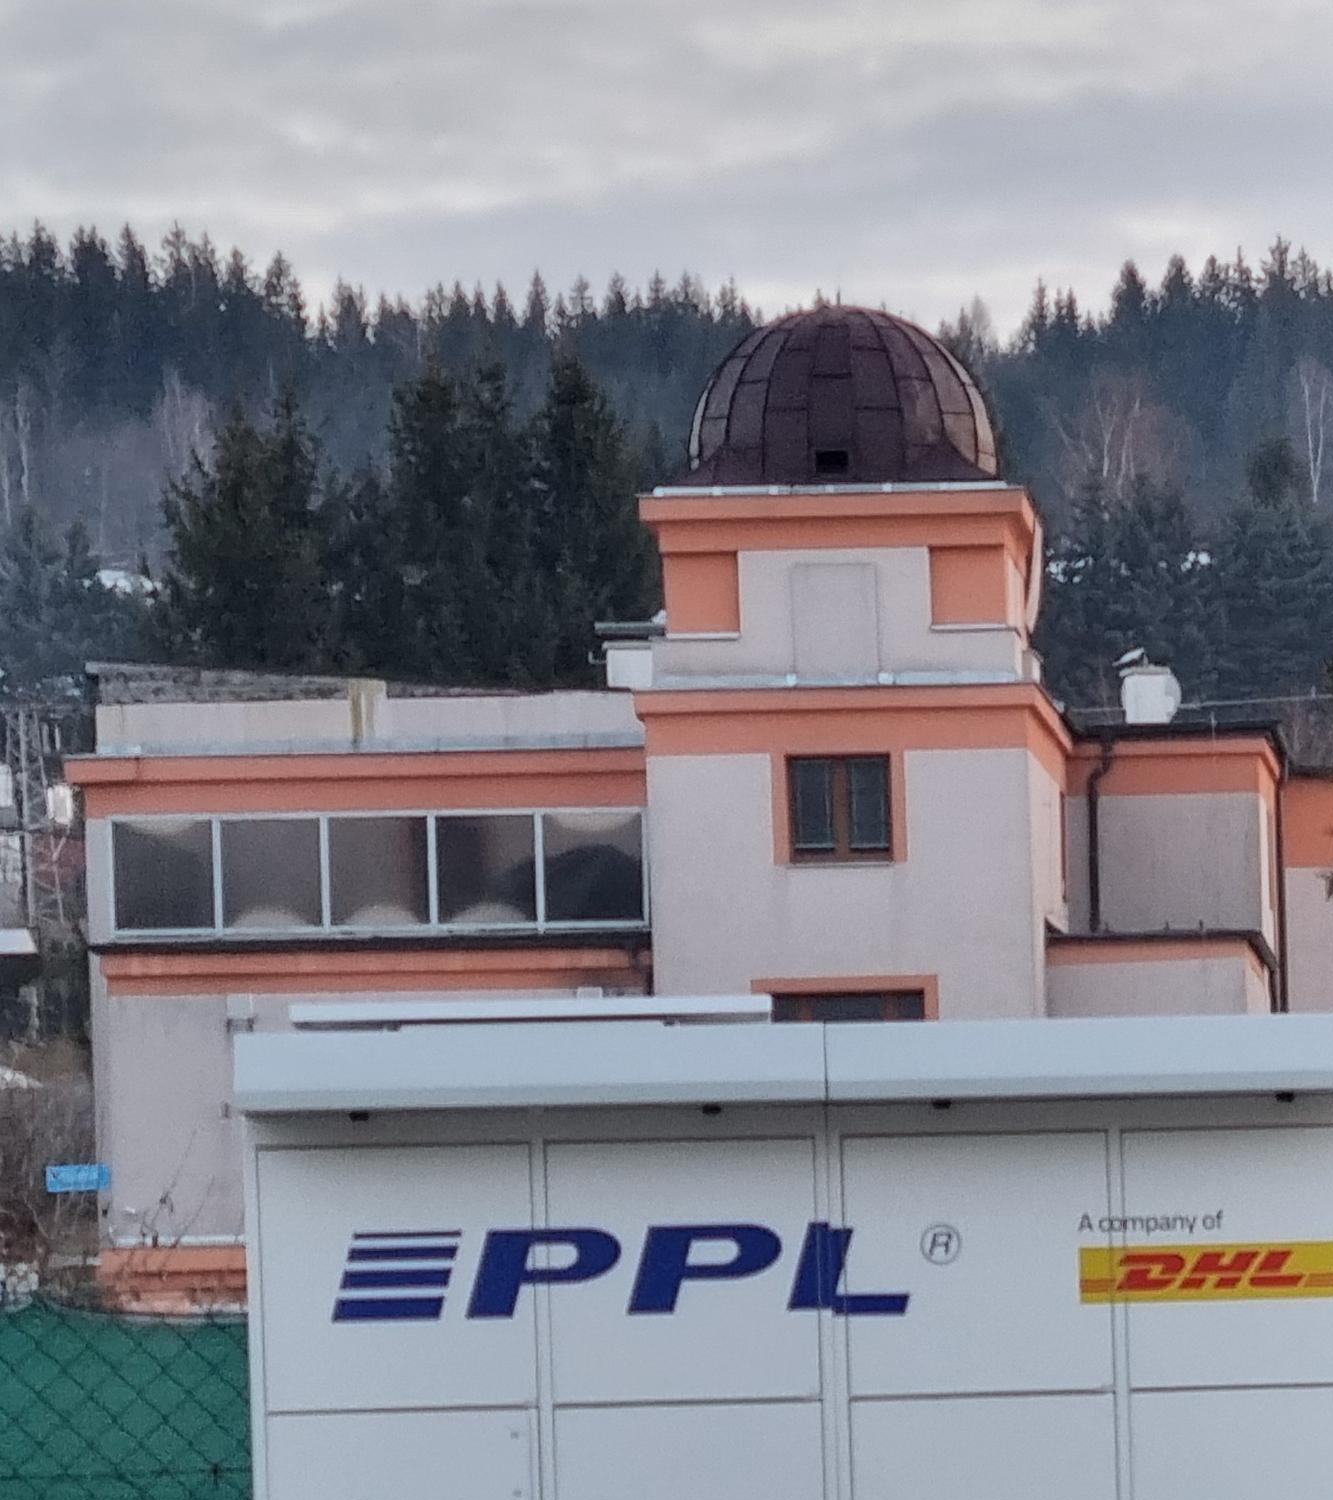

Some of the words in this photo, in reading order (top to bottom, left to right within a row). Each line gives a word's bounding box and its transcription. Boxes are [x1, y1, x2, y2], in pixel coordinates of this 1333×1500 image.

[1077, 1213, 1093, 1233] A
[1098, 1212, 1197, 1234] company
[1202, 1209, 1224, 1231] of
[466, 1221, 911, 1321] PPL
[1117, 1250, 1304, 1291] DHL
